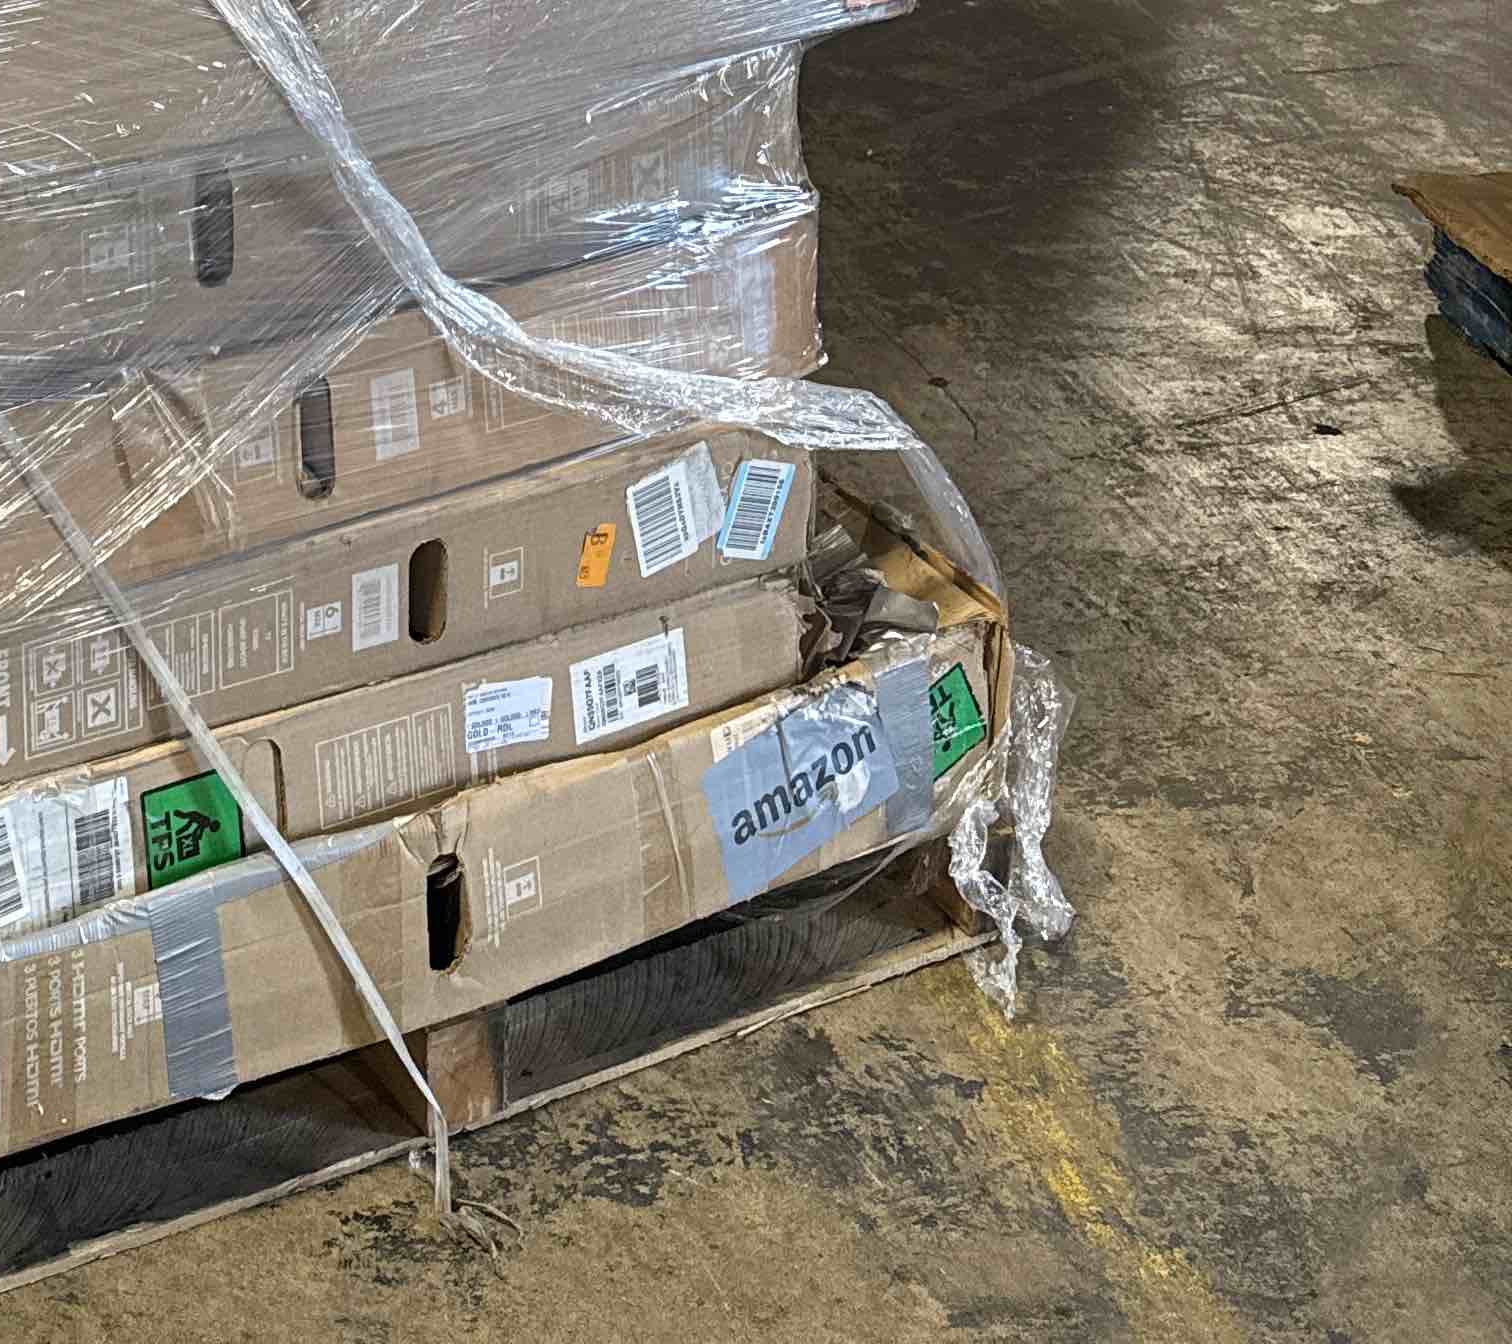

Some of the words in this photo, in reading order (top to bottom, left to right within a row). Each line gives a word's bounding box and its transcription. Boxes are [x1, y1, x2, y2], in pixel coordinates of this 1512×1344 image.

[731, 723, 879, 847] amazon
[148, 813, 176, 873] TPS
[23, 963, 37, 974] 3
[47, 956, 62, 967] 3
[71, 948, 84, 960] 3
[25, 976, 38, 1041] PUERTOS
[48, 969, 63, 1018] PORTS
[74, 1036, 88, 1082] PORTS
